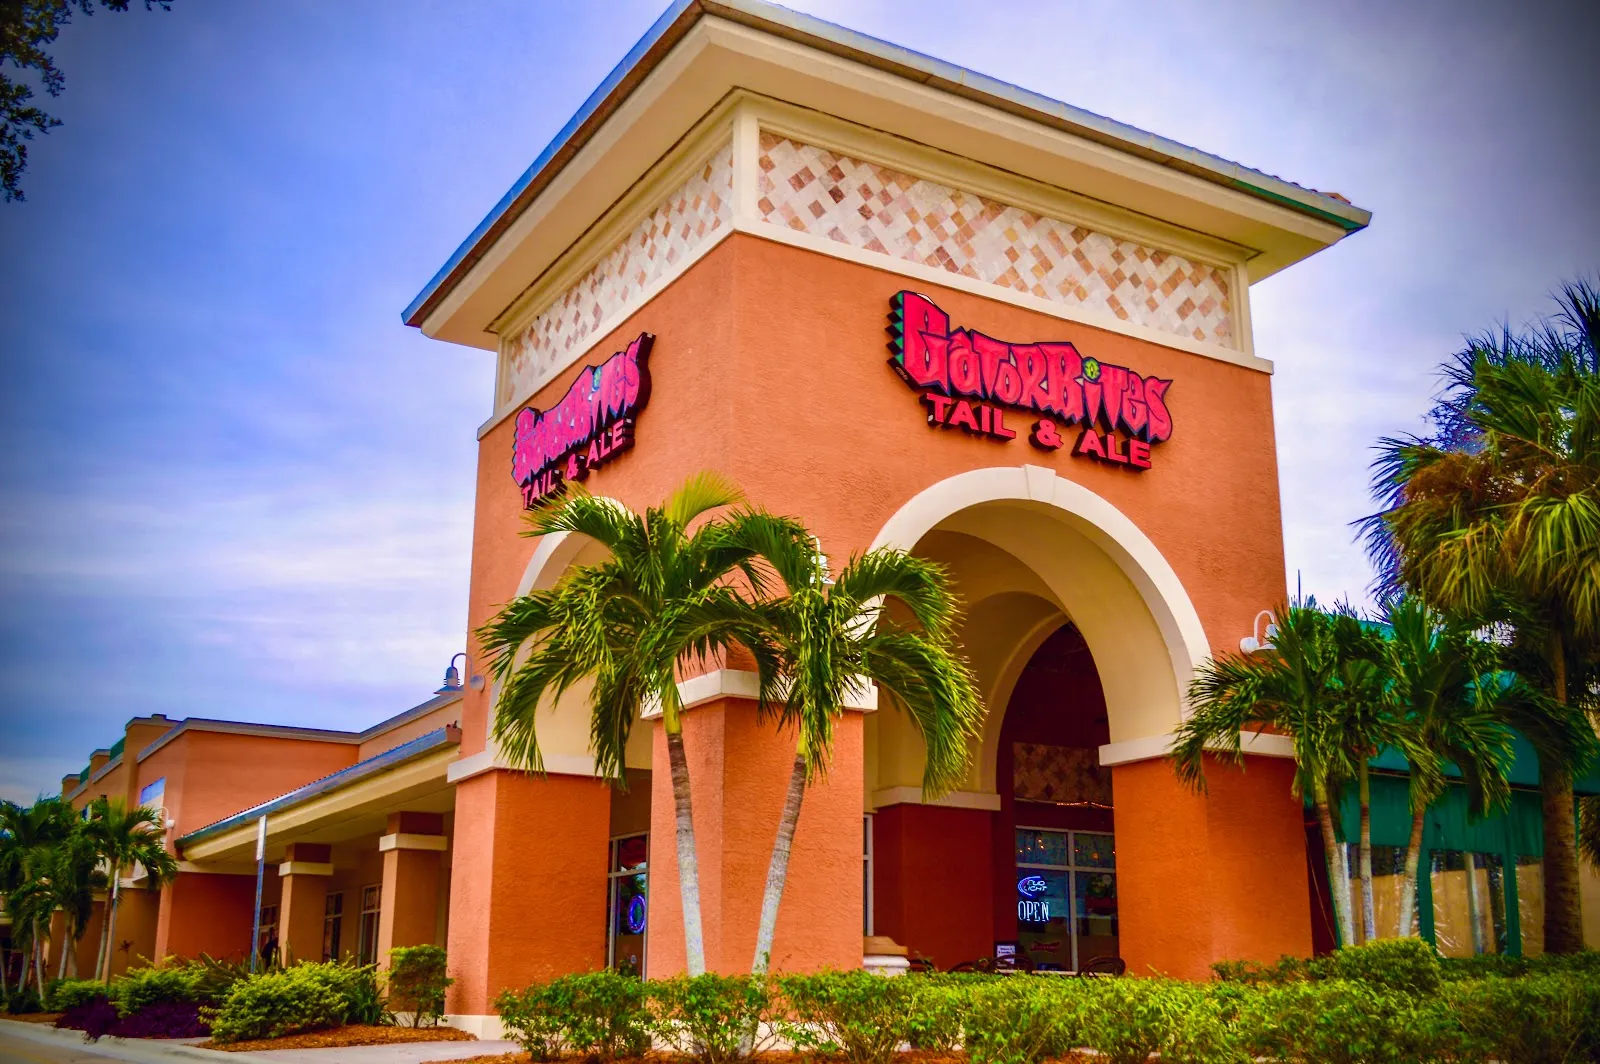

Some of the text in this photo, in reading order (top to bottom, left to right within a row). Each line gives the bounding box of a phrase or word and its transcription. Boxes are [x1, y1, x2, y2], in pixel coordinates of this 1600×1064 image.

[521, 419, 625, 511] TAIL & ALE
[925, 393, 1152, 469] TAIL & ALE
[1017, 900, 1050, 922] OPEN
